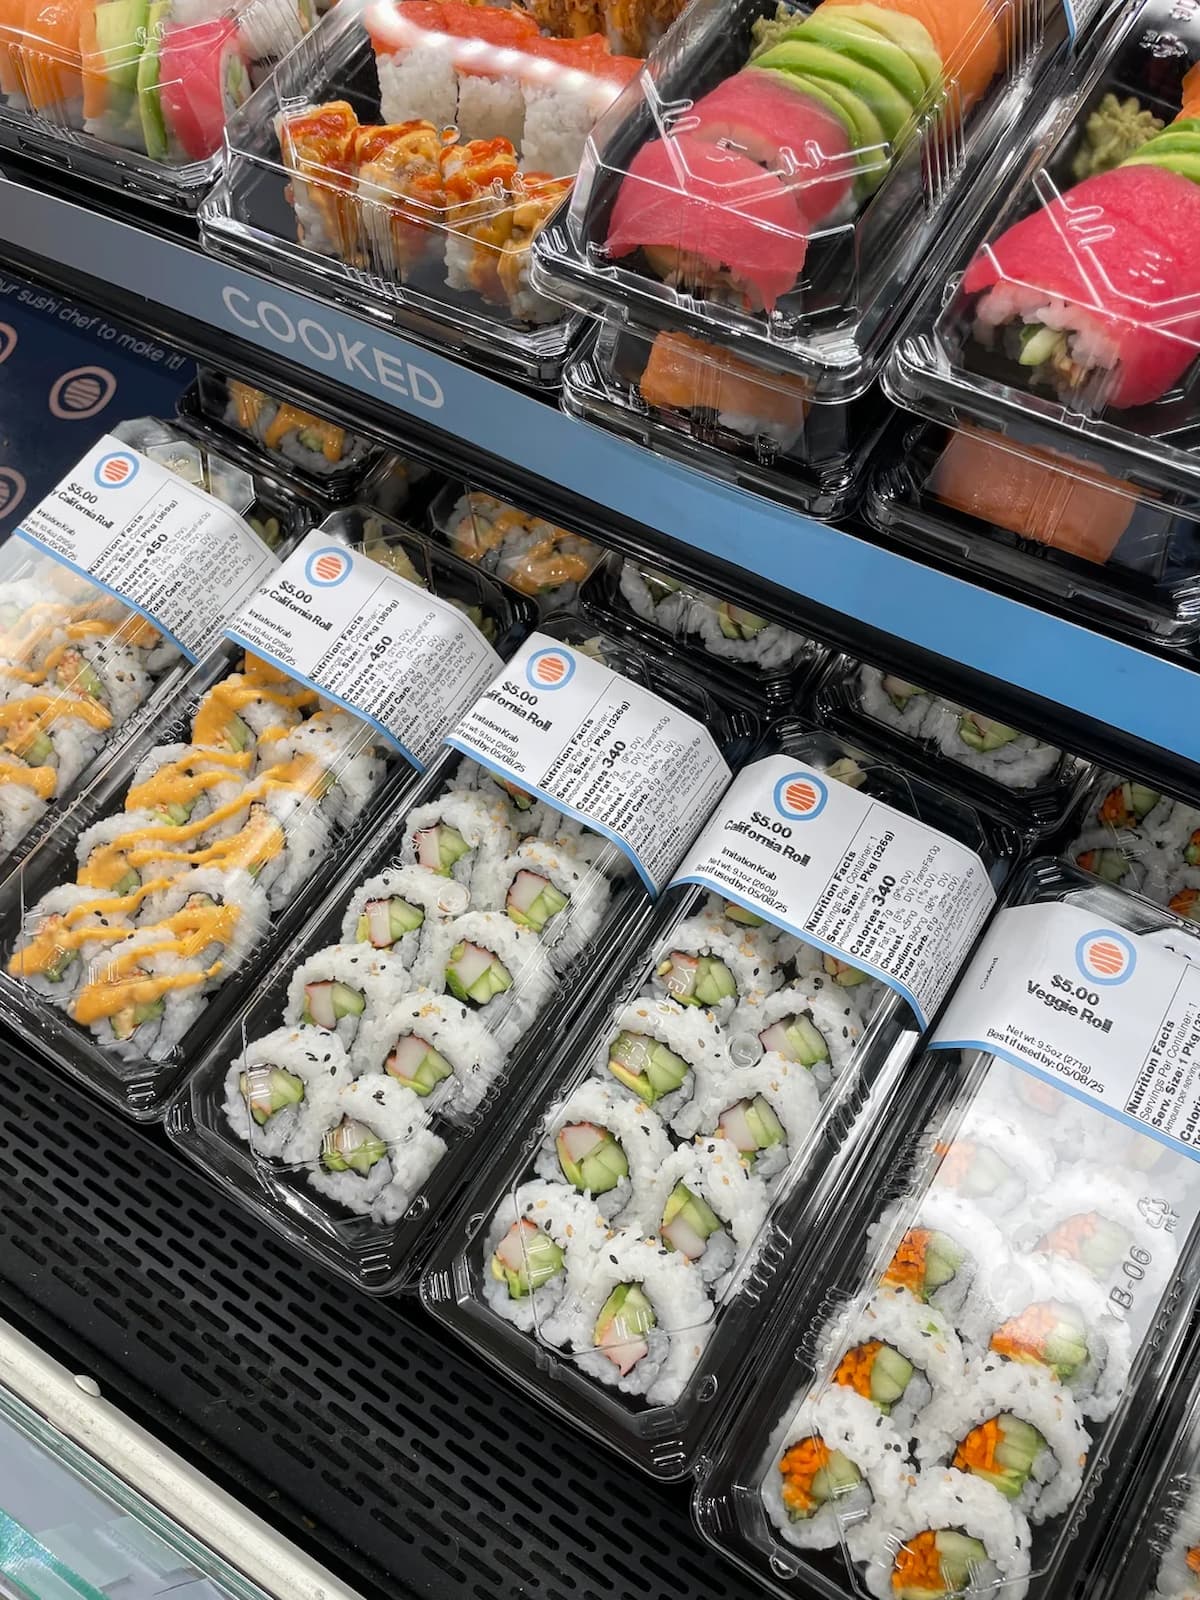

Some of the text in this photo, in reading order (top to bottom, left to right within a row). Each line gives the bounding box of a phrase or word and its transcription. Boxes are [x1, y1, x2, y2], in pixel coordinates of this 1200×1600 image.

[17, 289, 59, 315] sushi
[59, 307, 99, 330] chef
[97, 324, 116, 340] to
[117, 334, 164, 362] make
[165, 354, 187, 370] it!
[222, 286, 444, 408] COOKED
[58, 491, 114, 529] California Roll
[67, 482, 98, 504] $5.00
[87, 513, 143, 575] Nutrition Facts
[115, 531, 168, 593] Calories 450
[100, 562, 120, 584] Serv.
[279, 580, 313, 604] $5.00
[140, 582, 167, 610] Sodium
[148, 577, 184, 616] Total Carb.
[270, 590, 333, 631] California Roll
[168, 608, 193, 634] Protein
[275, 624, 293, 638] Krab
[263, 642, 297, 666] 05/08/25
[308, 614, 364, 681] Nutrition Facts
[323, 667, 343, 690] Serv.
[340, 646, 360, 669] Size:
[362, 623, 380, 643] Pkg
[375, 598, 399, 626] (369g)
[340, 634, 393, 701] Calories 450
[349, 671, 376, 704] Total Fat
[371, 689, 396, 718] Sodium
[377, 683, 412, 724] Total Carb.
[502, 681, 538, 706] $5.00
[500, 728, 520, 743] Krab
[527, 711, 553, 732] Roll
[478, 741, 491, 753] by:
[489, 747, 526, 773] 05/08/25
[539, 716, 594, 790] Nutrition Facts
[556, 774, 576, 799] Serv.
[572, 751, 592, 776] Size:
[593, 727, 611, 747] Pkg
[606, 699, 631, 729] (326g)
[570, 747, 584, 762] Per
[575, 739, 627, 810] Calories 340
[584, 793, 601, 814] Total
[598, 779, 611, 794] Fat
[599, 789, 626, 823] Cholest.
[608, 797, 633, 828] Sodium
[616, 812, 634, 833] Total
[631, 790, 650, 813] Carb.
[750, 810, 792, 839] $5.00
[721, 846, 777, 881] Imitation Krab
[724, 819, 812, 867] California Roll
[714, 869, 789, 914] used by: 05/08/25
[732, 868, 752, 883] 9.1oz
[751, 877, 779, 898] (260g)
[805, 848, 856, 932] Nutrition Facts
[816, 834, 877, 938] Servings Per Container: 1
[826, 829, 895, 943] Serv. Size: 1 Pkg (326g)
[836, 885, 875, 947] Amount per serving
[848, 873, 897, 955] Calories 340
[859, 934, 877, 959] Total
[873, 919, 886, 935] Fat
[881, 908, 893, 921] 7g
[879, 931, 905, 969] Cholest.
[890, 915, 928, 976] Sodium 840mg
[899, 915, 940, 980] Total Carb. 61g
[1027, 979, 1114, 1034] Veggie Roll
[1050, 974, 1100, 1007] $5.00
[986, 1027, 1105, 1094] Best if used by: 05/08/25
[1006, 1024, 1091, 1076] Net wt: 9.5oz (271g)
[1126, 1020, 1175, 1115] Nutrition Facts
[1140, 1079, 1165, 1121] Servings
[1157, 1060, 1173, 1078] Per
[1167, 1010, 1194, 1060] Container:
[1151, 1098, 1172, 1127] Serv.
[1165, 1066, 1185, 1096] Size:
[1181, 1034, 1200, 1057] Pkg
[1163, 1061, 1200, 1133] Amount per serving
